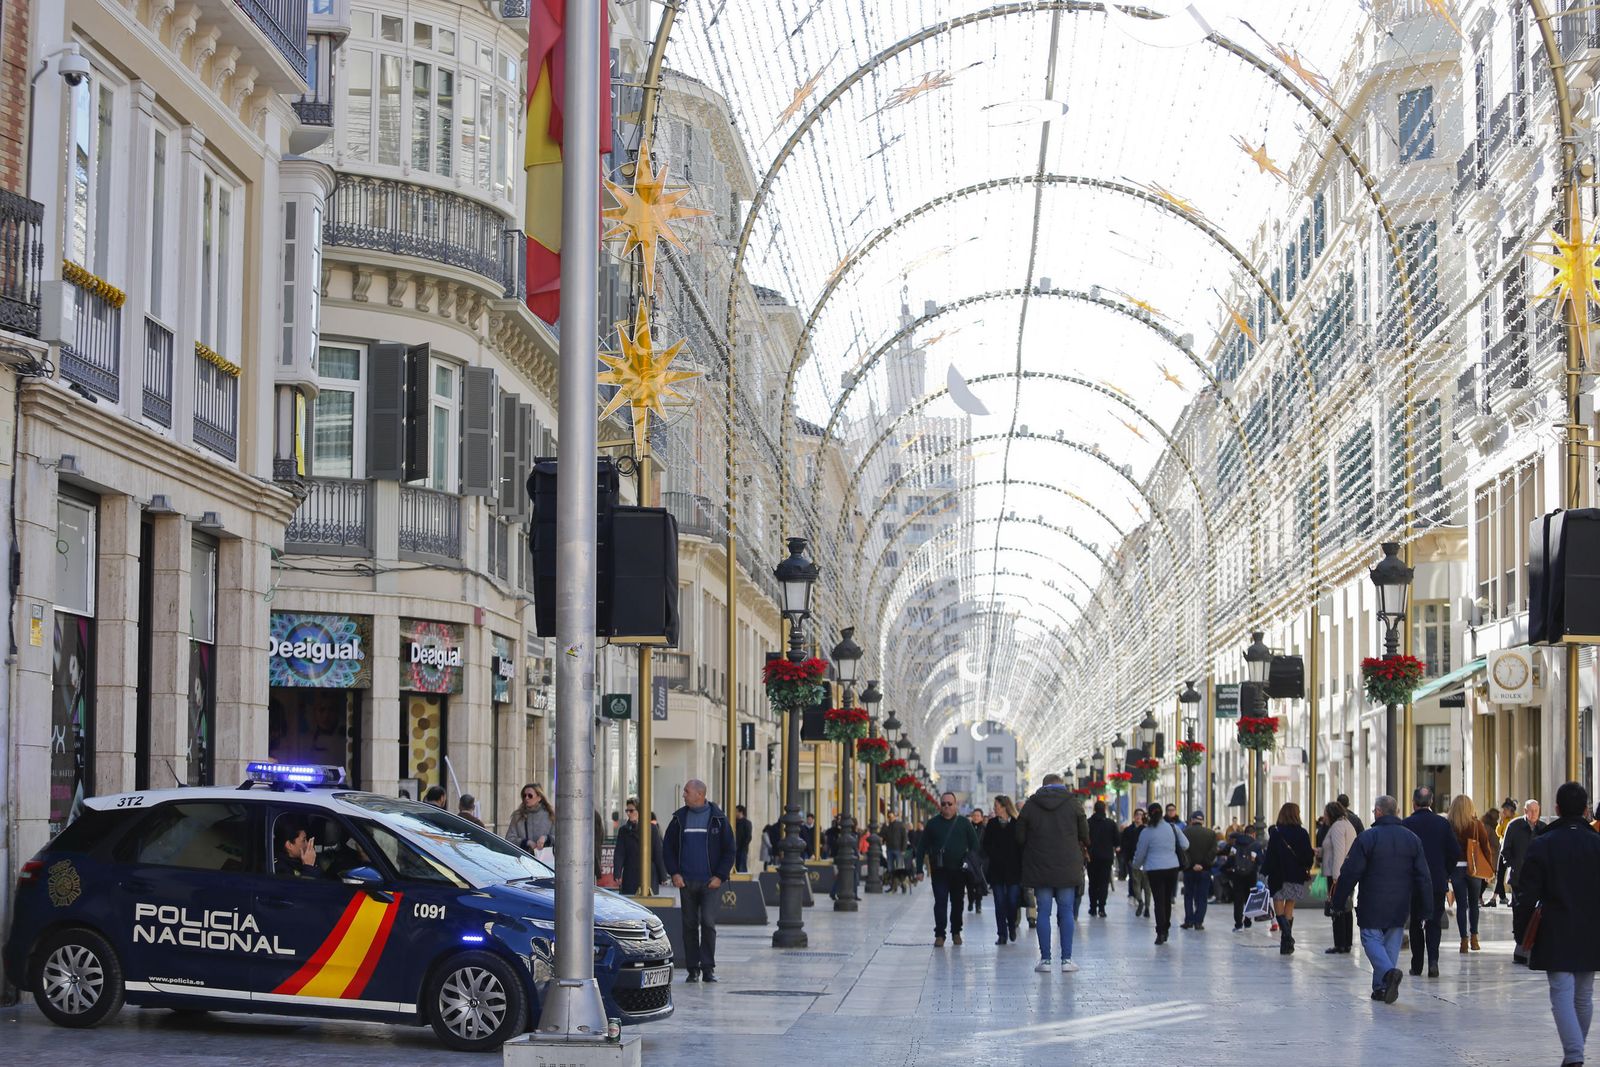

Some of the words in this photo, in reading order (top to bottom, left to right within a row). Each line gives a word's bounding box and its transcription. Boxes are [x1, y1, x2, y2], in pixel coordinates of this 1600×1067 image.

[411, 642, 462, 669] Desigual
[654, 686, 667, 718] Etam
[117, 795, 144, 807] 3T2
[135, 902, 260, 933] POLICÍA
[133, 924, 296, 956] NACIONAL
[148, 976, 205, 986] www.policia.es
